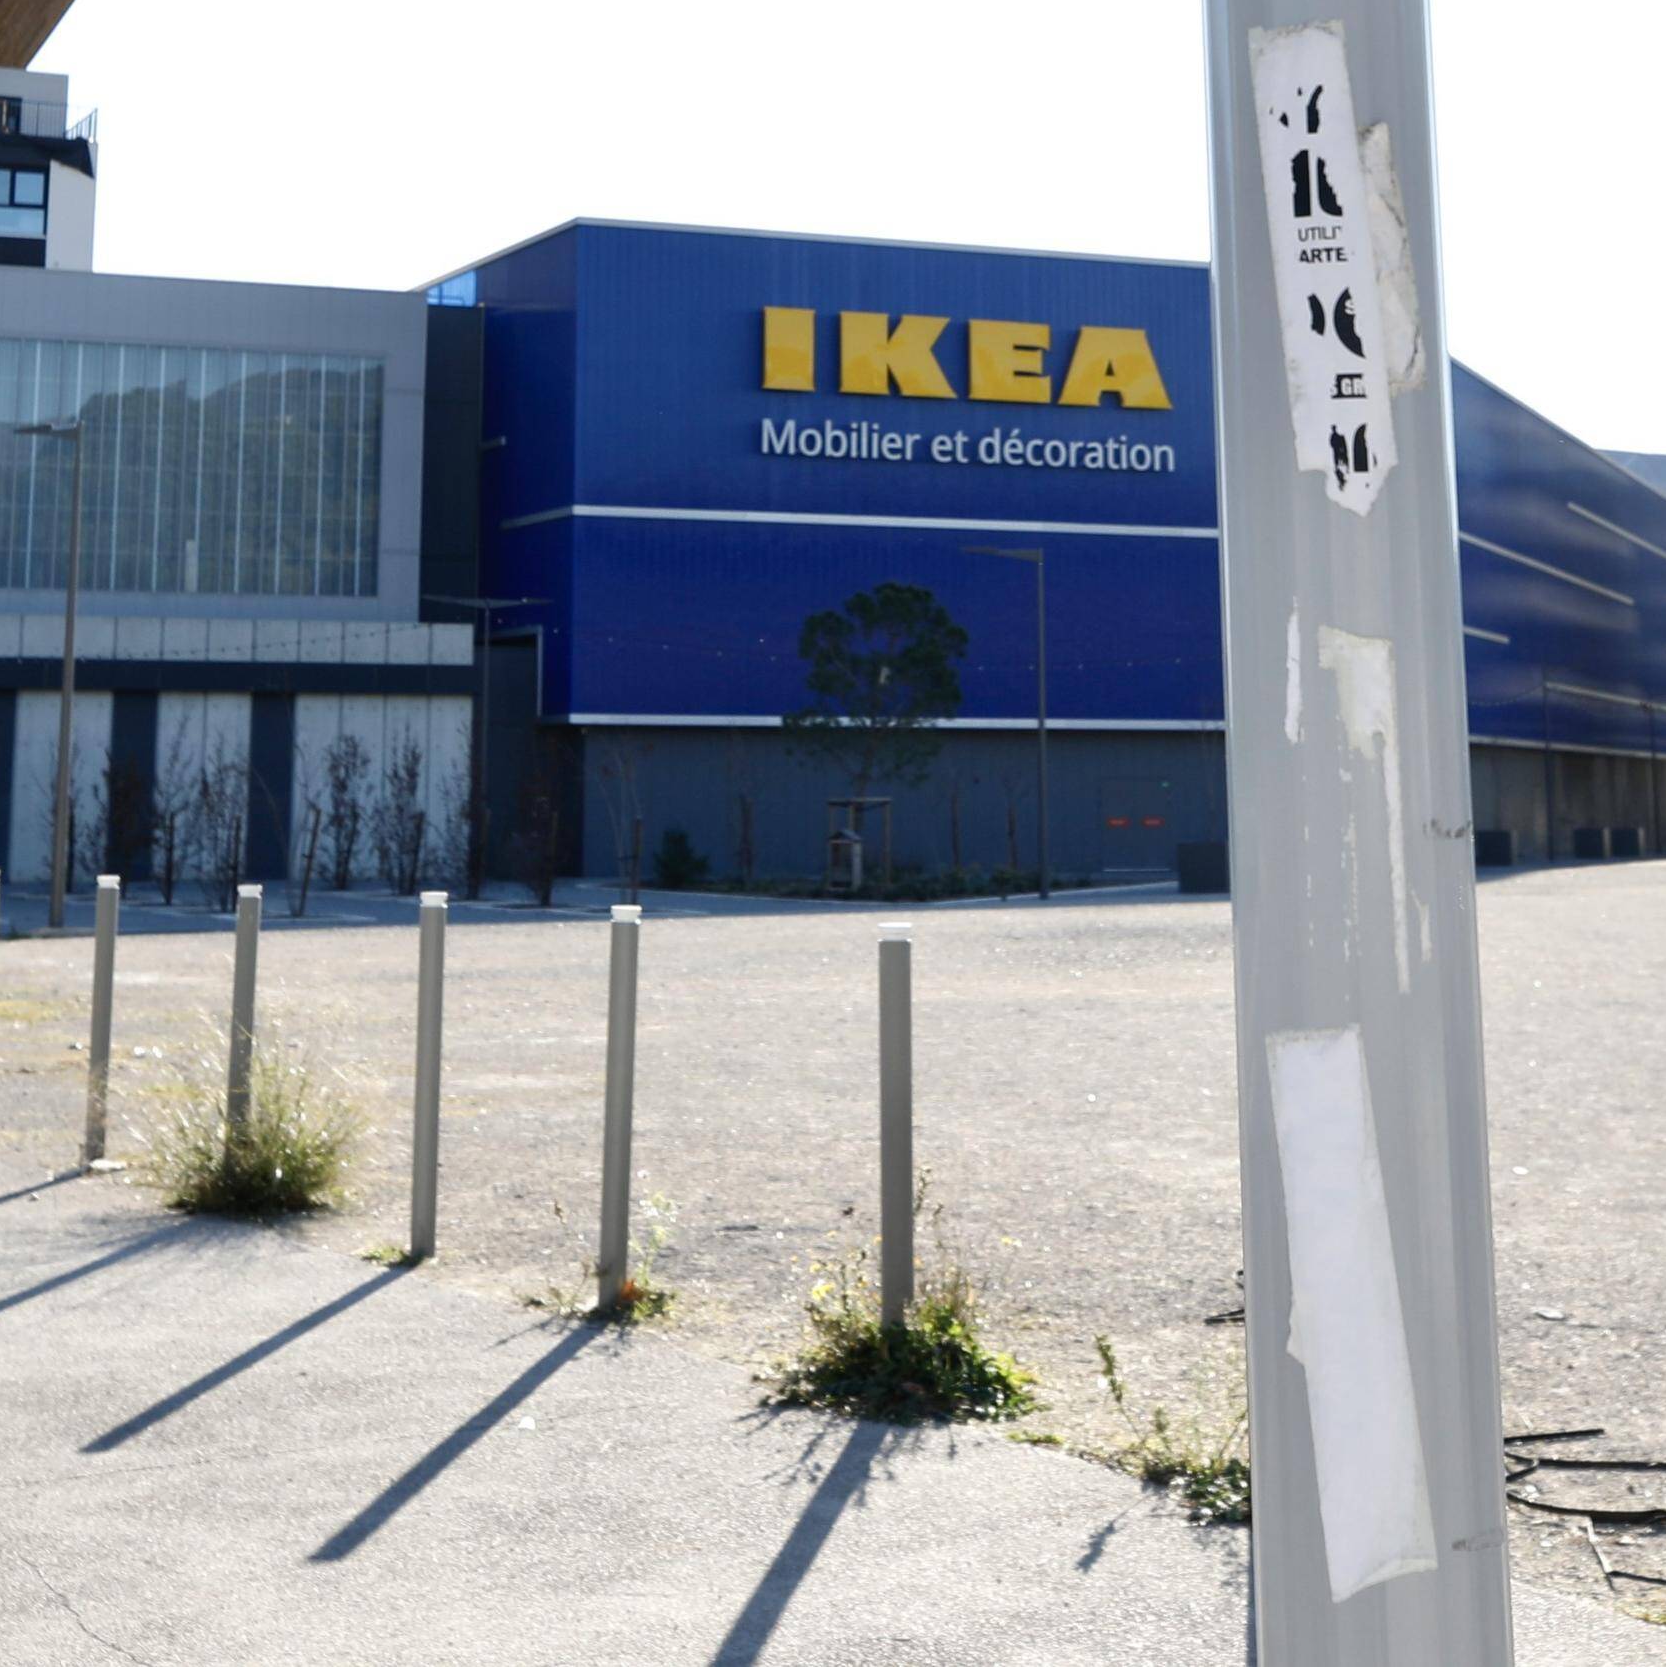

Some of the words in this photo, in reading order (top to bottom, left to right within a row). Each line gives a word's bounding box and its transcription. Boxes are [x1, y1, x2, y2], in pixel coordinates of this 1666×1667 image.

[762, 306, 1173, 410] IKEA
[761, 417, 921, 461] Mobilier
[931, 425, 969, 464] et
[978, 427, 1175, 472] décoration
